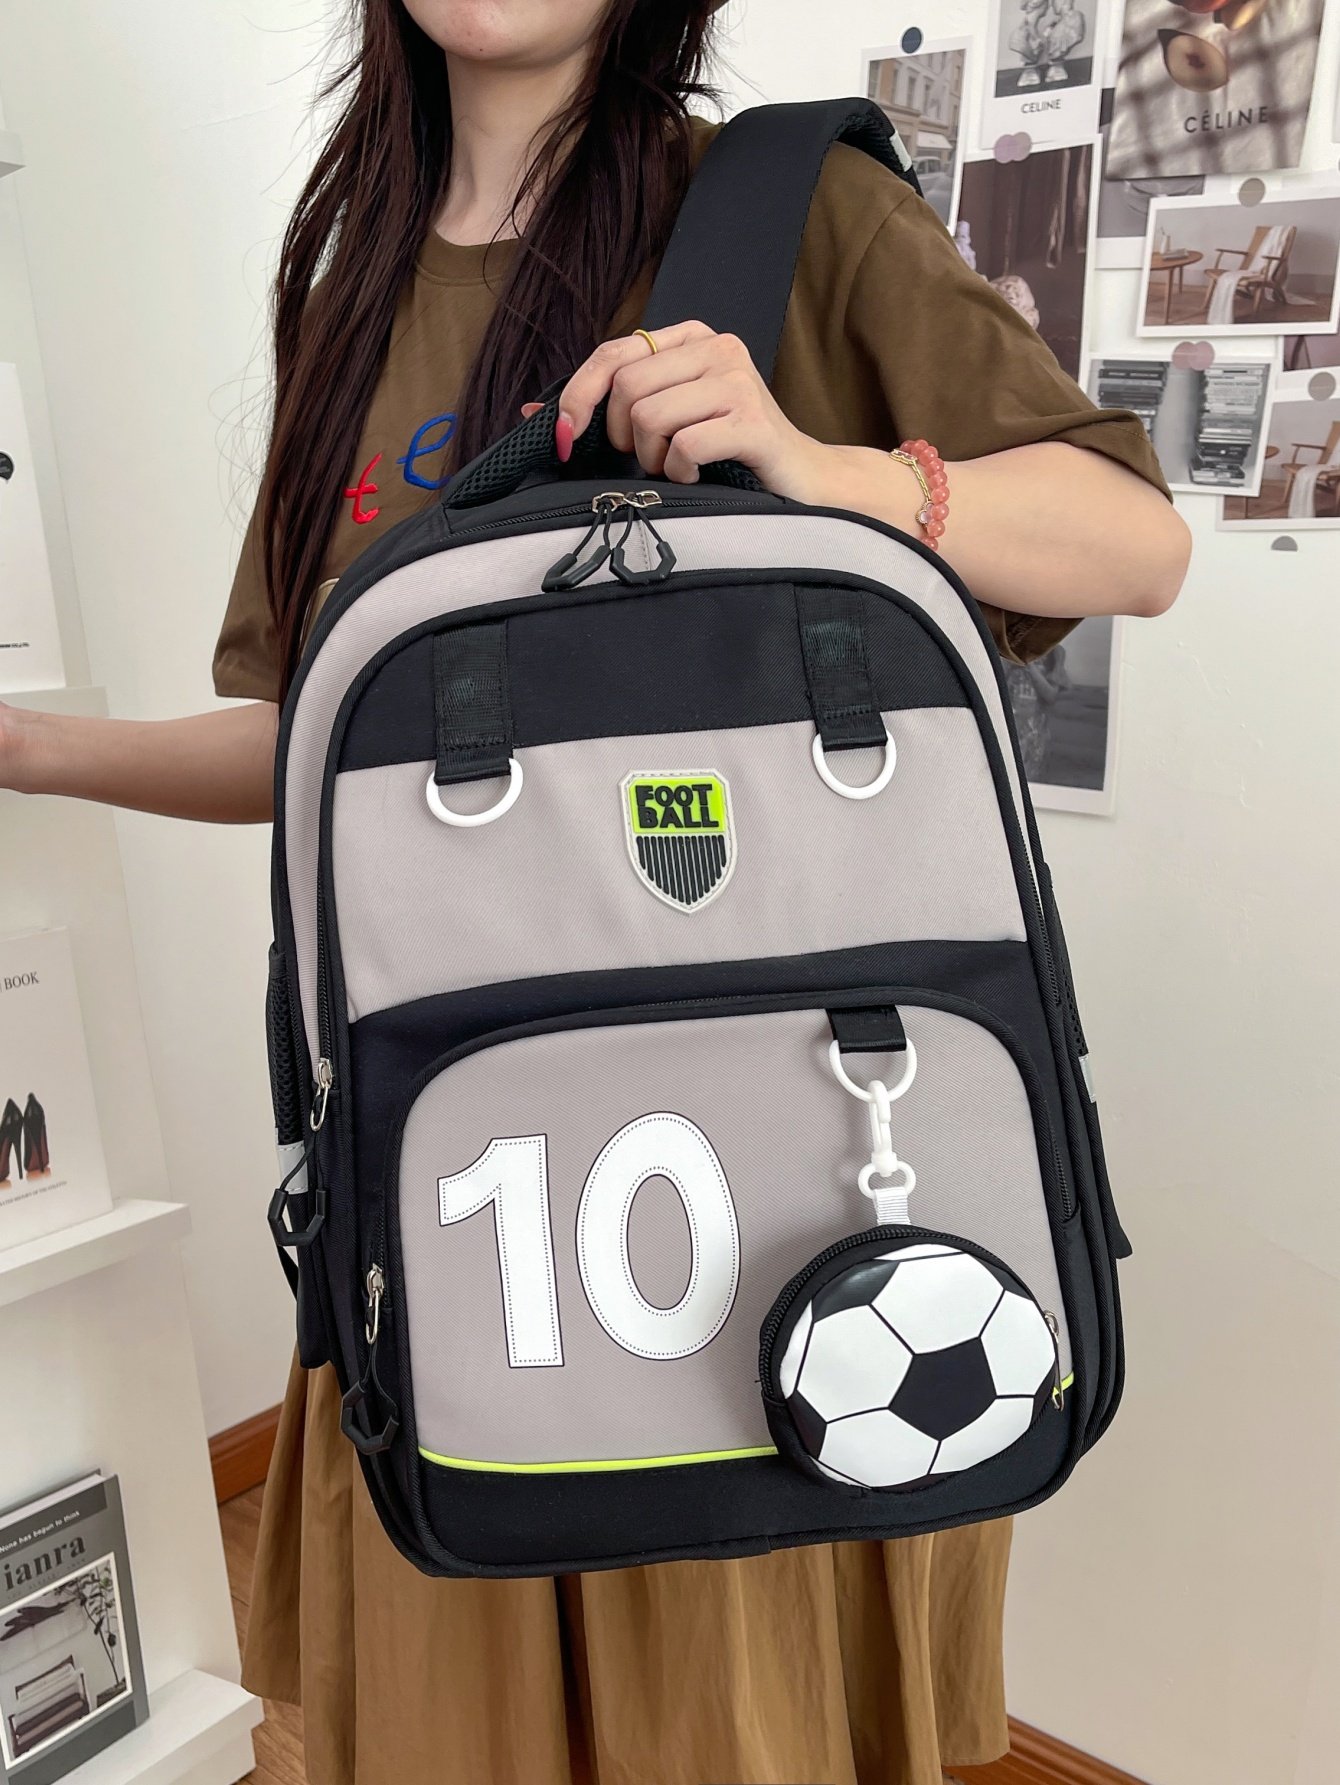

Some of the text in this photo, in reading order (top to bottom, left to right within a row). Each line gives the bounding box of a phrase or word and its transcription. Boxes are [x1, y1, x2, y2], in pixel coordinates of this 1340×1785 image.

[1020, 98, 1062, 114] CELINE
[1183, 105, 1269, 134] CÉLINE
[635, 783, 713, 808] FOOT
[637, 805, 720, 829] BALL
[4, 970, 40, 991] BOOK
[437, 1110, 742, 1369] 10
[18, 1533, 32, 1544] has
